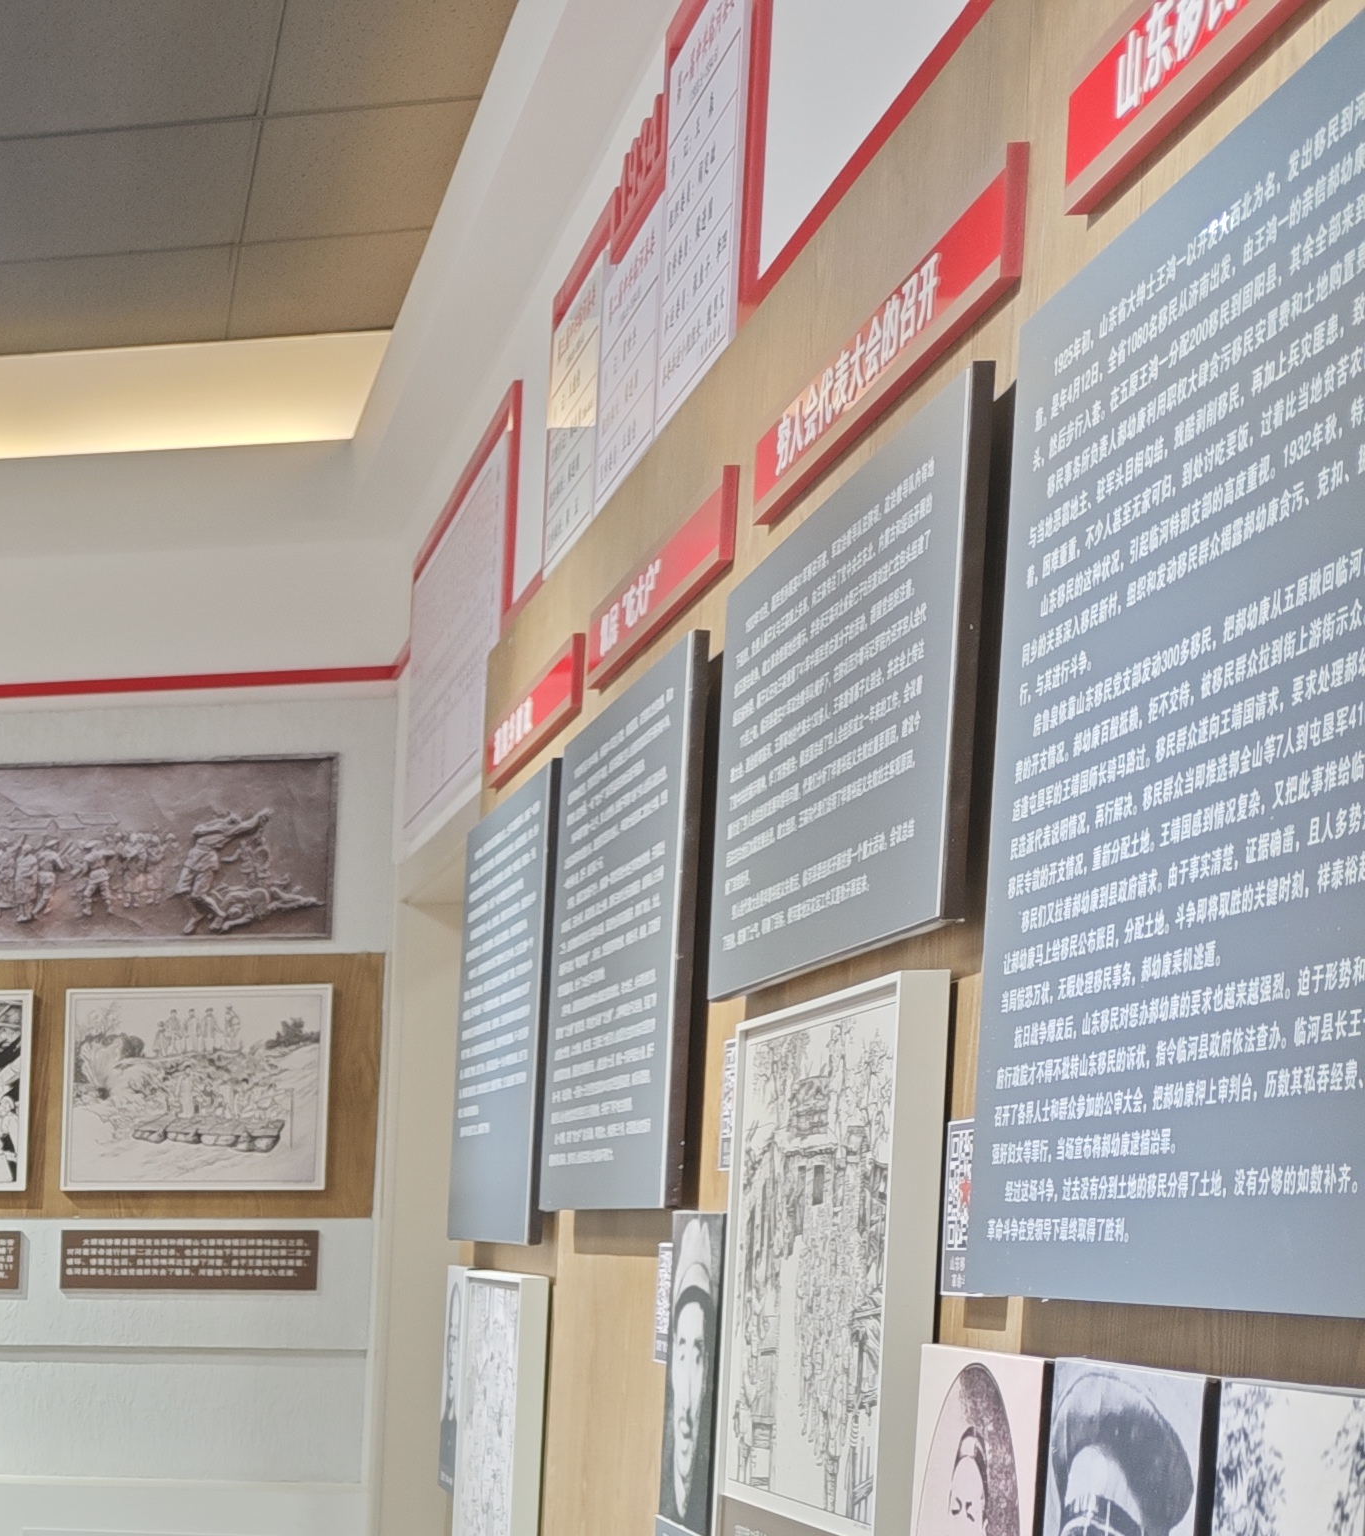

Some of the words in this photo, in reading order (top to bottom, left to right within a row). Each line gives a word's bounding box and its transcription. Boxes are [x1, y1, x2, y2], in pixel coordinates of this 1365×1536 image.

[774, 253, 941, 477] 穷人会代表大会的召开
